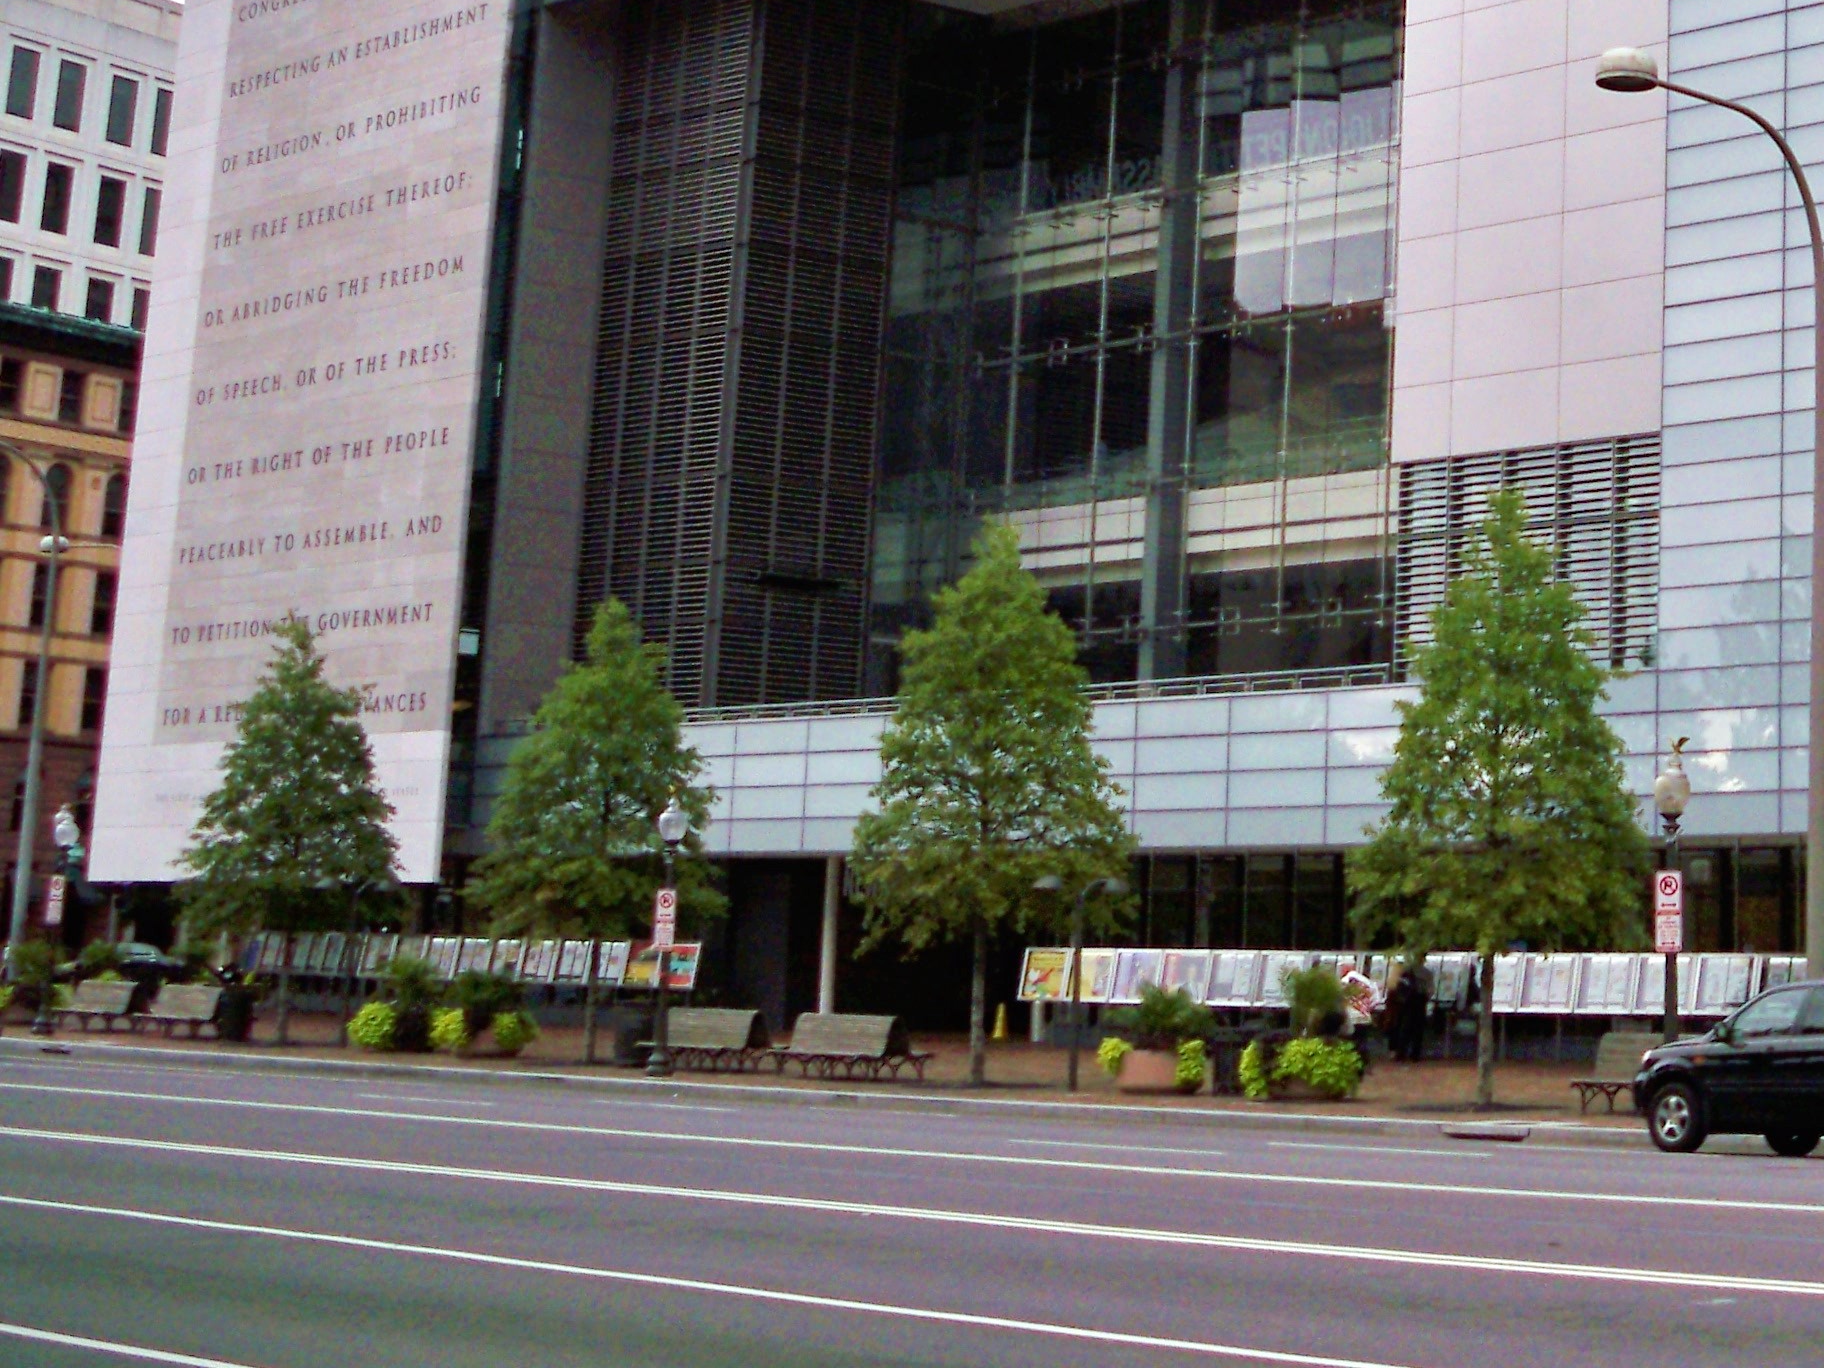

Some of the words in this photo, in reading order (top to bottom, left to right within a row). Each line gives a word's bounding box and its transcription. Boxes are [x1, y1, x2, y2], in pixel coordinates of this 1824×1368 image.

[228, 55, 320, 98] RESPECTING
[327, 47, 348, 68] AN
[355, 2, 489, 60] ESTABLISHMENT
[221, 154, 238, 174] OF
[335, 121, 356, 142] OR
[365, 85, 481, 134] PROHIBITING
[213, 228, 242, 250] THE
[251, 216, 288, 241] FREE
[297, 194, 374, 231] EXERCISE
[204, 309, 224, 329] OR
[231, 284, 328, 323] ABRIDGING
[337, 276, 370, 299] THE
[380, 255, 464, 290] FREEDOM
[196, 387, 214, 406] OF
[296, 367, 316, 388] OR
[325, 361, 345, 382] OF
[355, 352, 388, 376] THE
[187, 466, 206, 485] OR
[214, 460, 242, 480] THE
[251, 449, 304, 476] RIGHT
[311, 446, 333, 466] OF
[341, 438, 374, 461] THE
[384, 426, 449, 455] PEOPLE
[178, 538, 265, 565] PEACEABLY
[274, 533, 295, 553] TO
[405, 514, 443, 538] AND
[171, 626, 190, 646] TO
[198, 617, 270, 643] PETITION
[317, 603, 433, 632] GOVERNMENT
[162, 708, 190, 726] FOR
[197, 706, 207, 724] A
